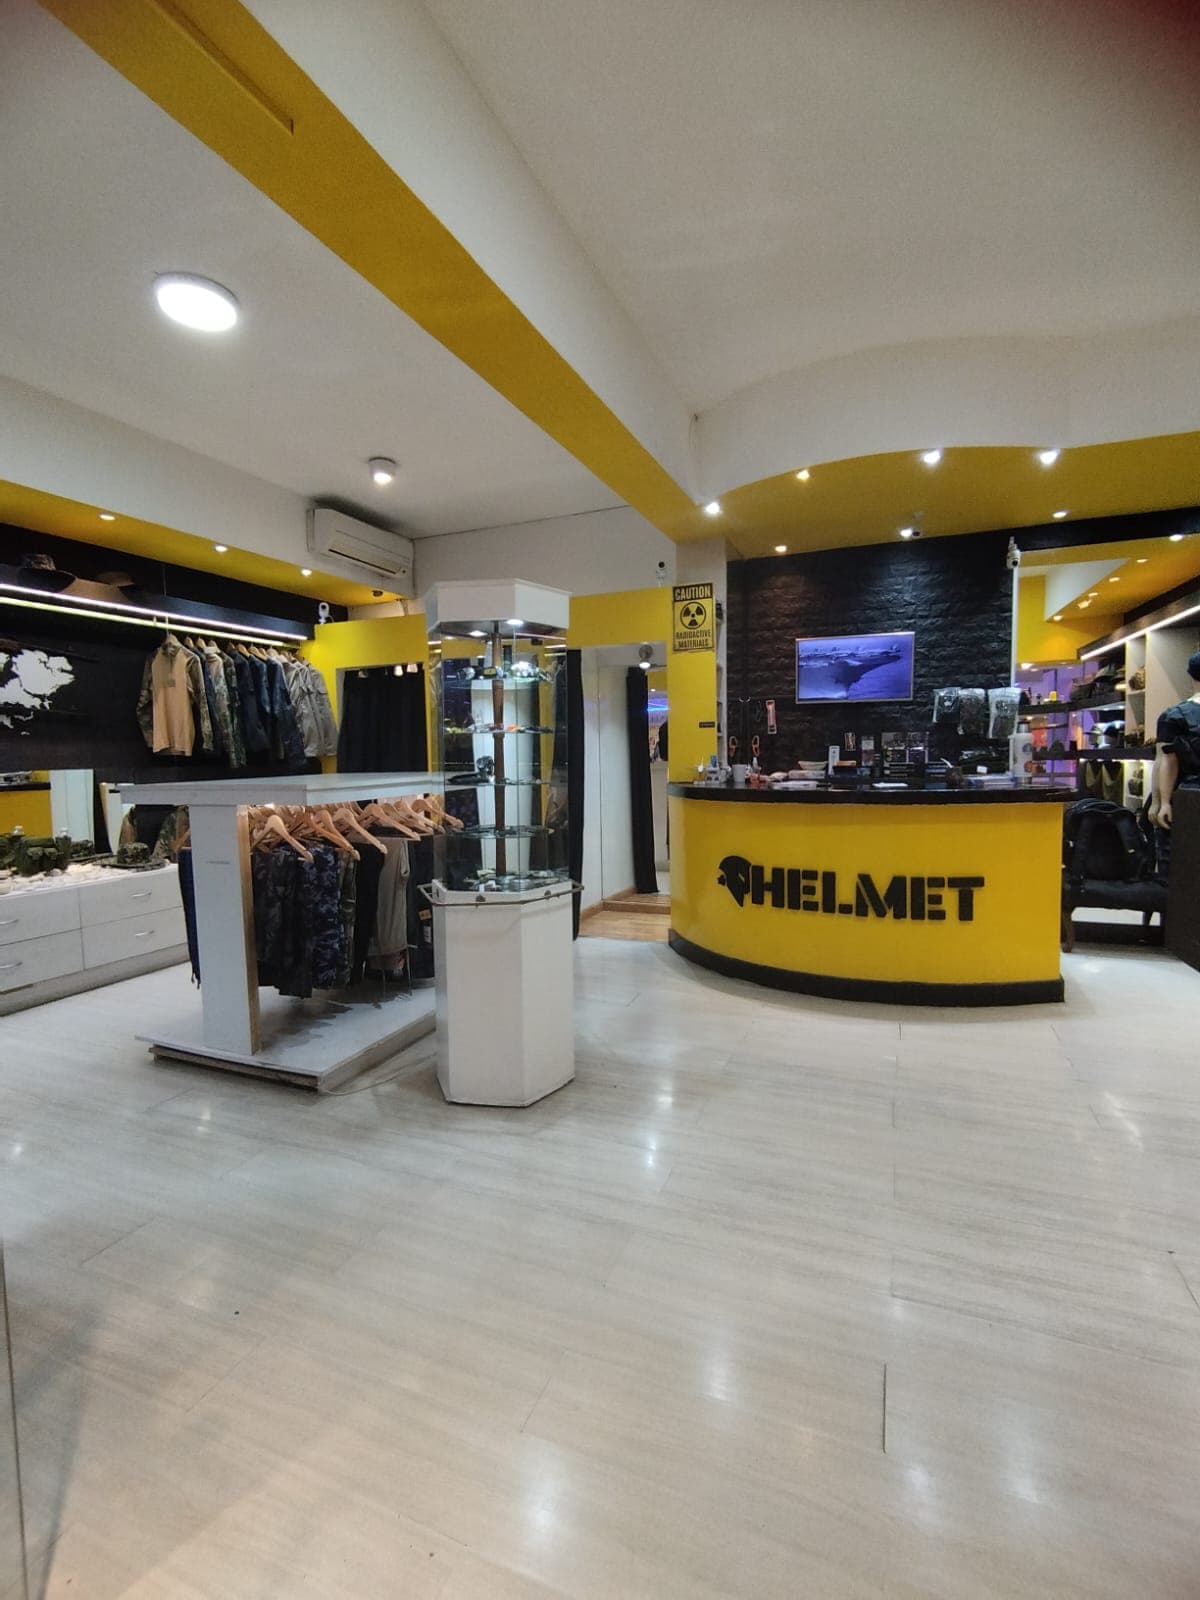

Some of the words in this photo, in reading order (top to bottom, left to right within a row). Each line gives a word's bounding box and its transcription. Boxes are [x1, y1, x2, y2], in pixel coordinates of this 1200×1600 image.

[674, 584, 711, 601] CAUTION
[676, 629, 711, 640] RADIOACTIVE
[678, 639, 709, 648] MATERIALS
[751, 864, 985, 921] HELMET
